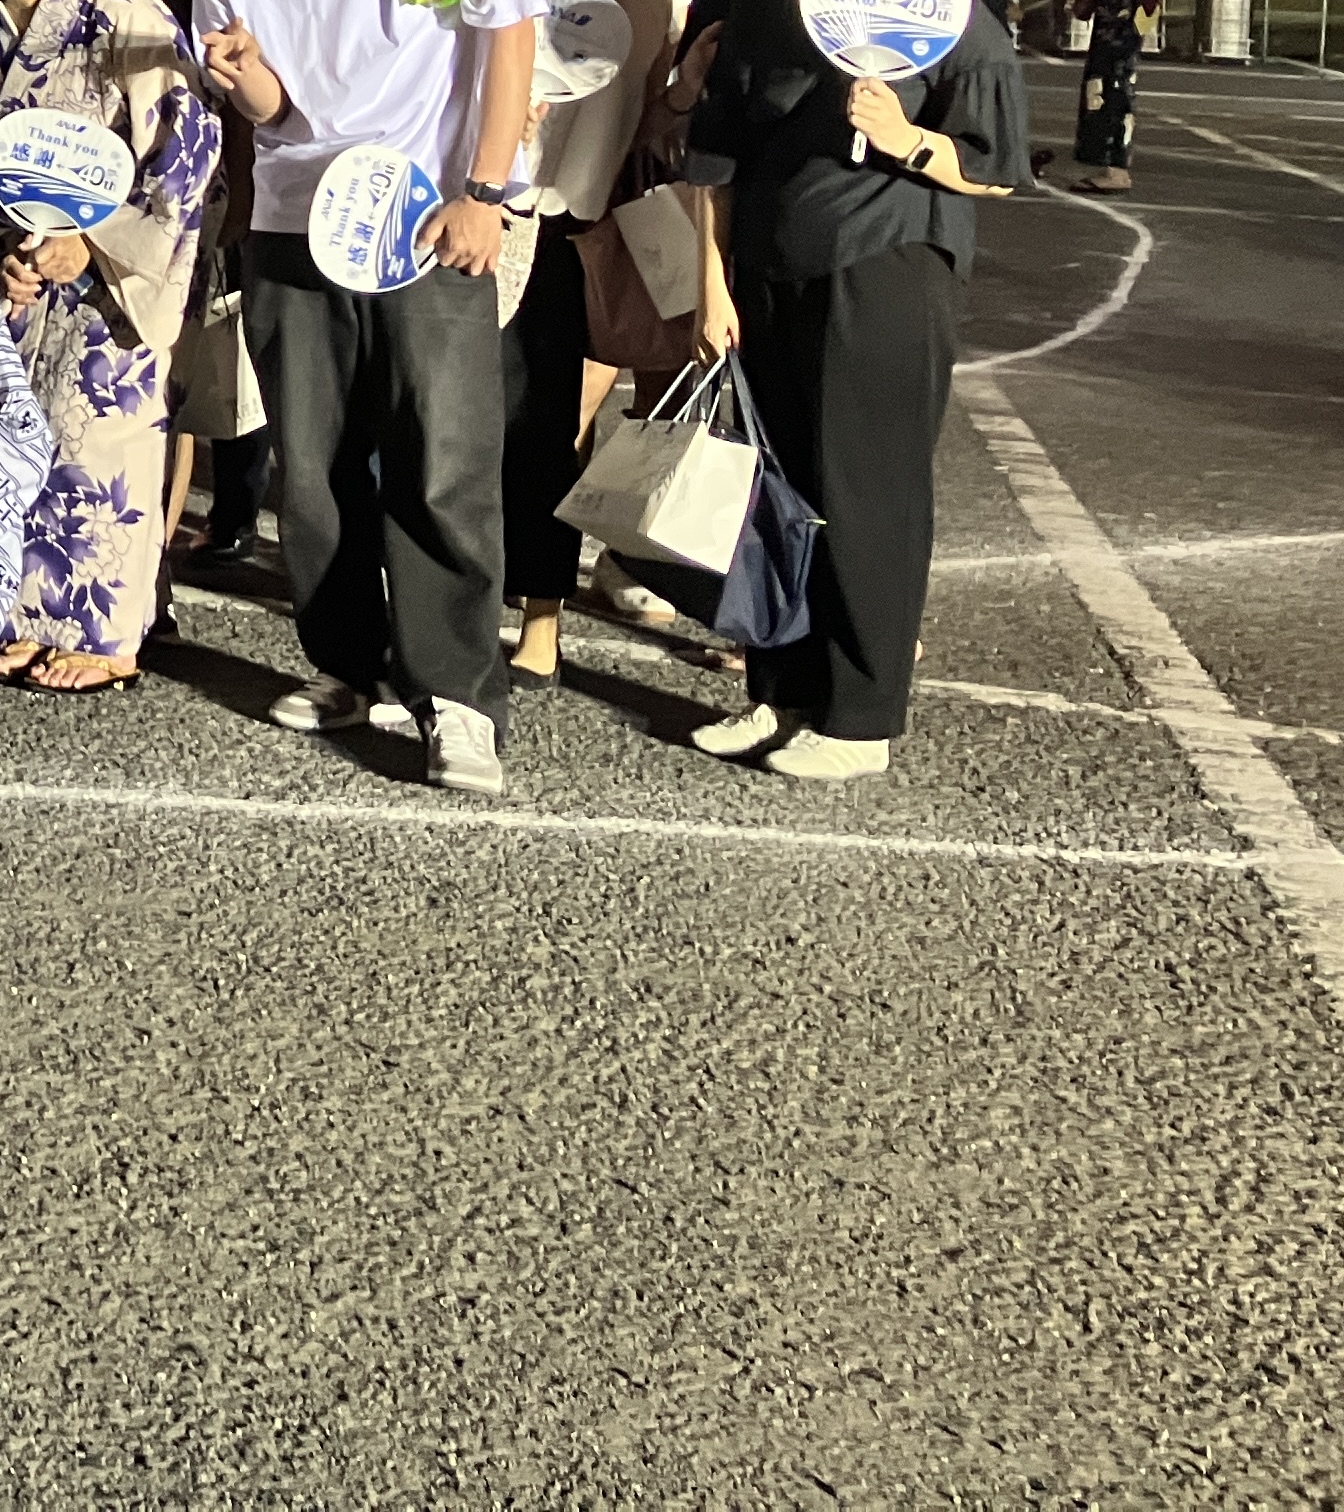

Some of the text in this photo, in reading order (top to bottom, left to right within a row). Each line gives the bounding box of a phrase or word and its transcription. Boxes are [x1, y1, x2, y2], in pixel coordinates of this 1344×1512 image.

[28, 126, 99, 157] Thank you
[329, 177, 360, 247] Thank you
